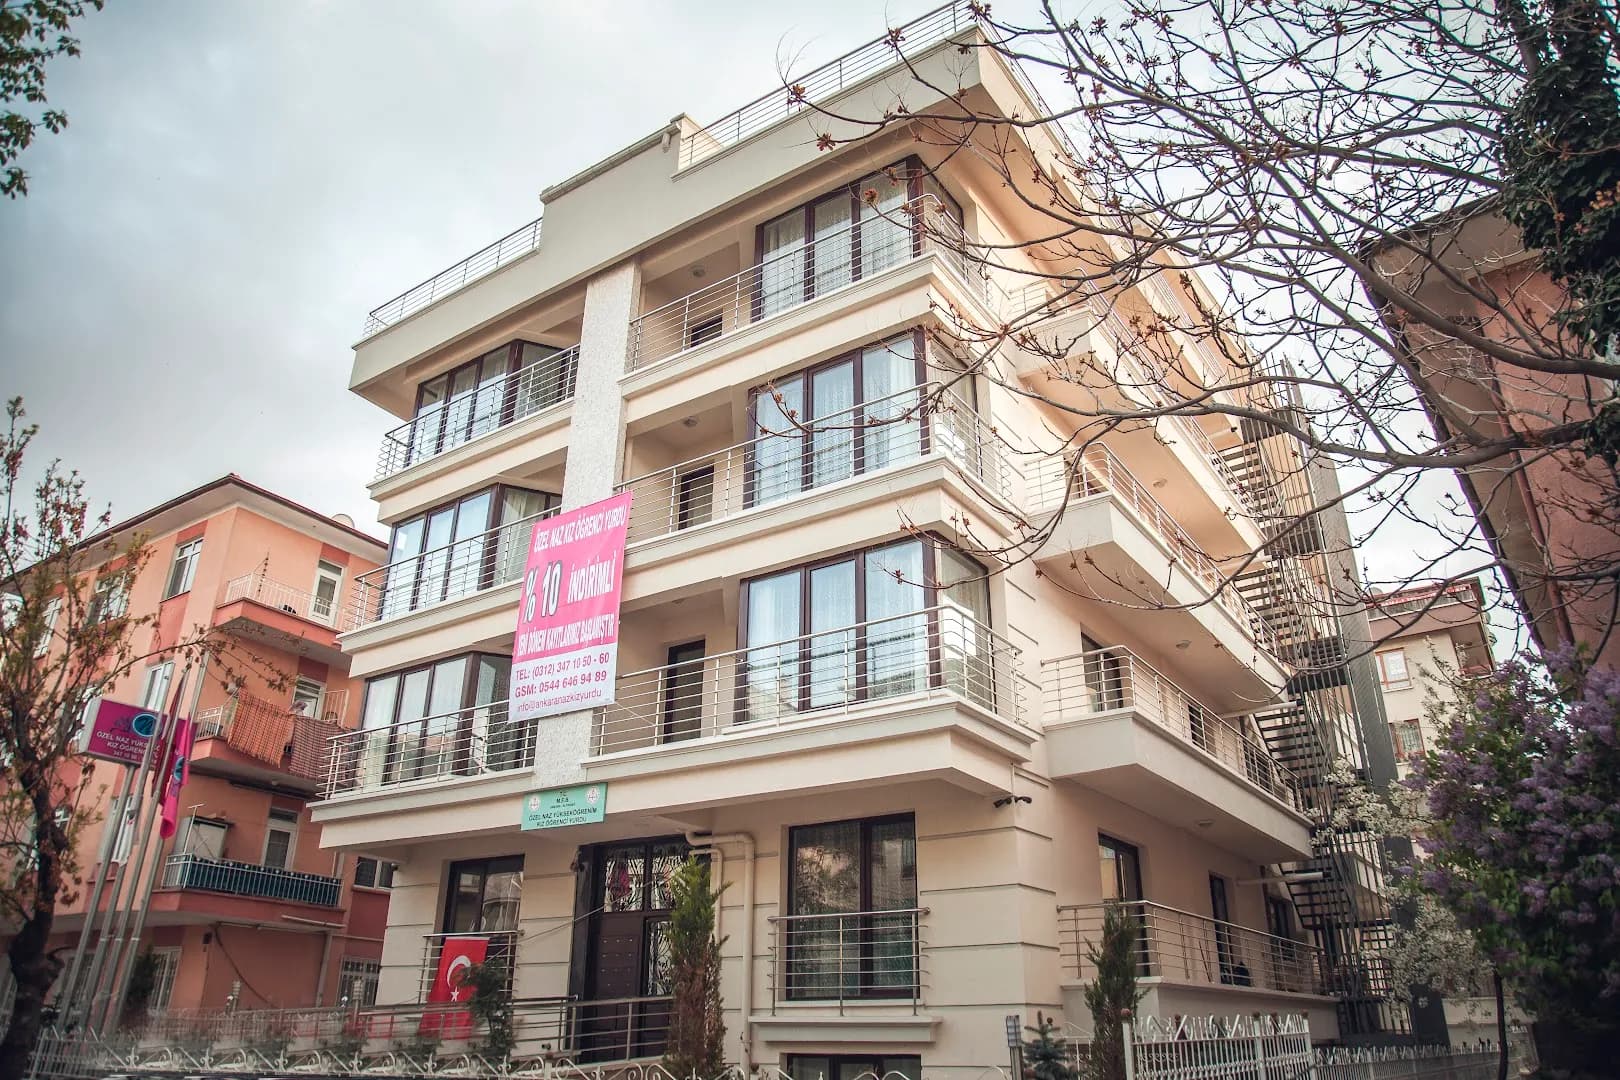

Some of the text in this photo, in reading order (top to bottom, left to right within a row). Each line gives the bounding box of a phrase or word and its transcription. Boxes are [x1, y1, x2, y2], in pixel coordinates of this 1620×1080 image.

[534, 504, 627, 553] ÖZEL NAZ KIZ ÖĞRENCİ YURDU
[523, 550, 618, 624] % 10 İNDİRİMLİ
[515, 670, 607, 698] GSM: 0544 646 94 89
[516, 668, 530, 681] TEL:
[532, 664, 555, 680] (0312)
[556, 659, 571, 673] 347
[573, 657, 581, 669] 10
[582, 655, 592, 667] 50
[599, 652, 610, 664] 60
